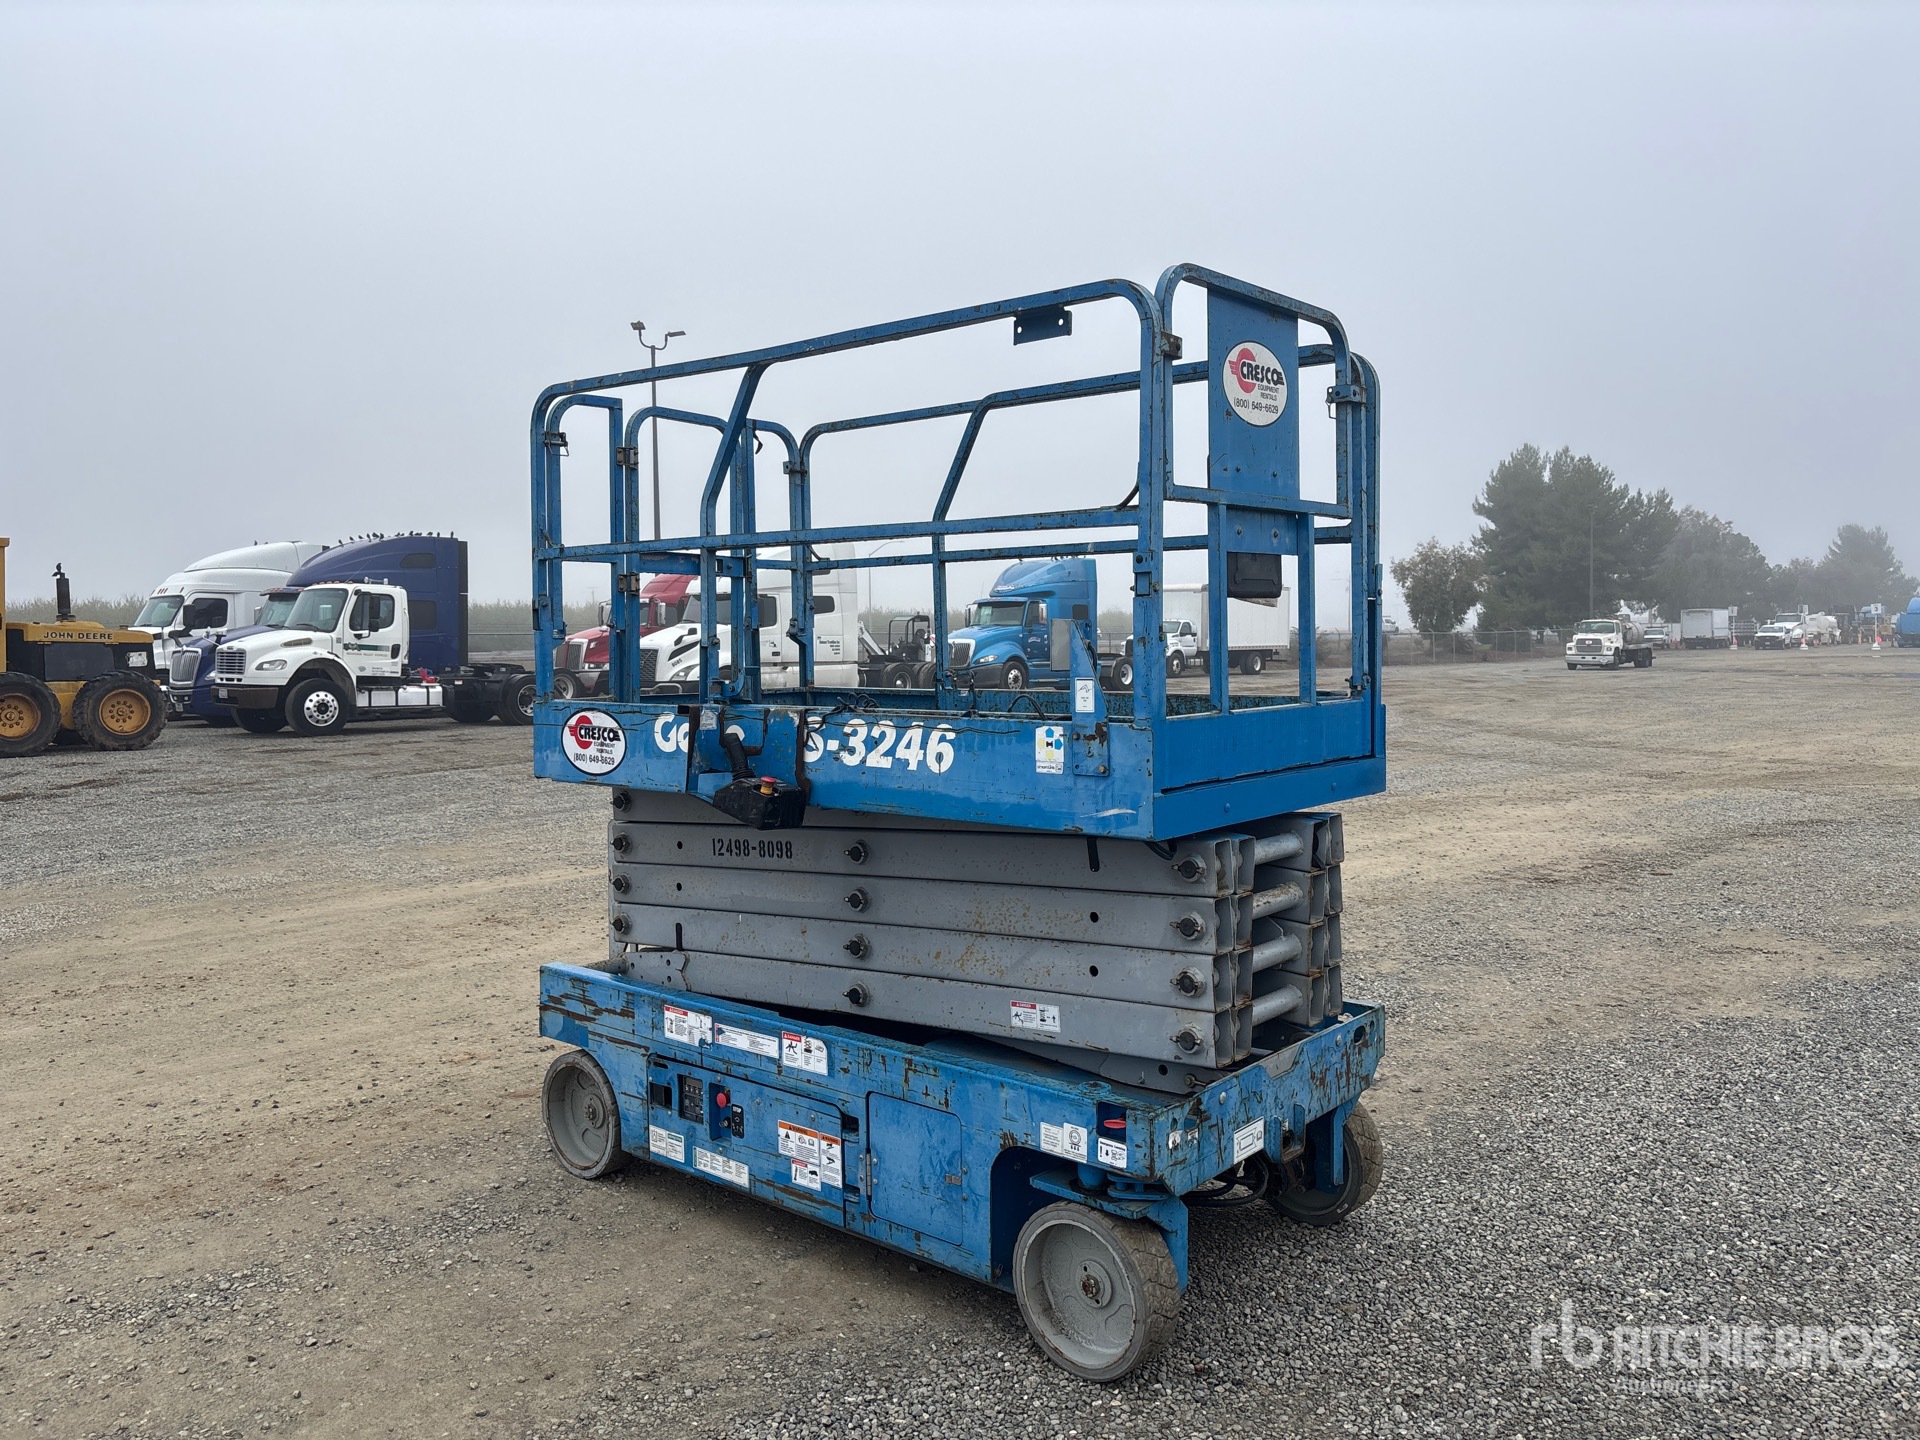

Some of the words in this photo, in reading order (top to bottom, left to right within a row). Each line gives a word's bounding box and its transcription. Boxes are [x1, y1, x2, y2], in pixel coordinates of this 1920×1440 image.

[1240, 361, 1285, 386] CRESCO
[1257, 383, 1280, 394] EQUIPMENT
[1260, 392, 1277, 402] RENTALS
[1233, 397, 1250, 410] (800)
[1251, 401, 1279, 414] 649-6629
[43, 631, 73, 639] JOHN
[77, 632, 113, 640] DEERE
[578, 725, 621, 742] CRESCO
[573, 752, 588, 764] (800)
[712, 838, 793, 860] 12498-8098
